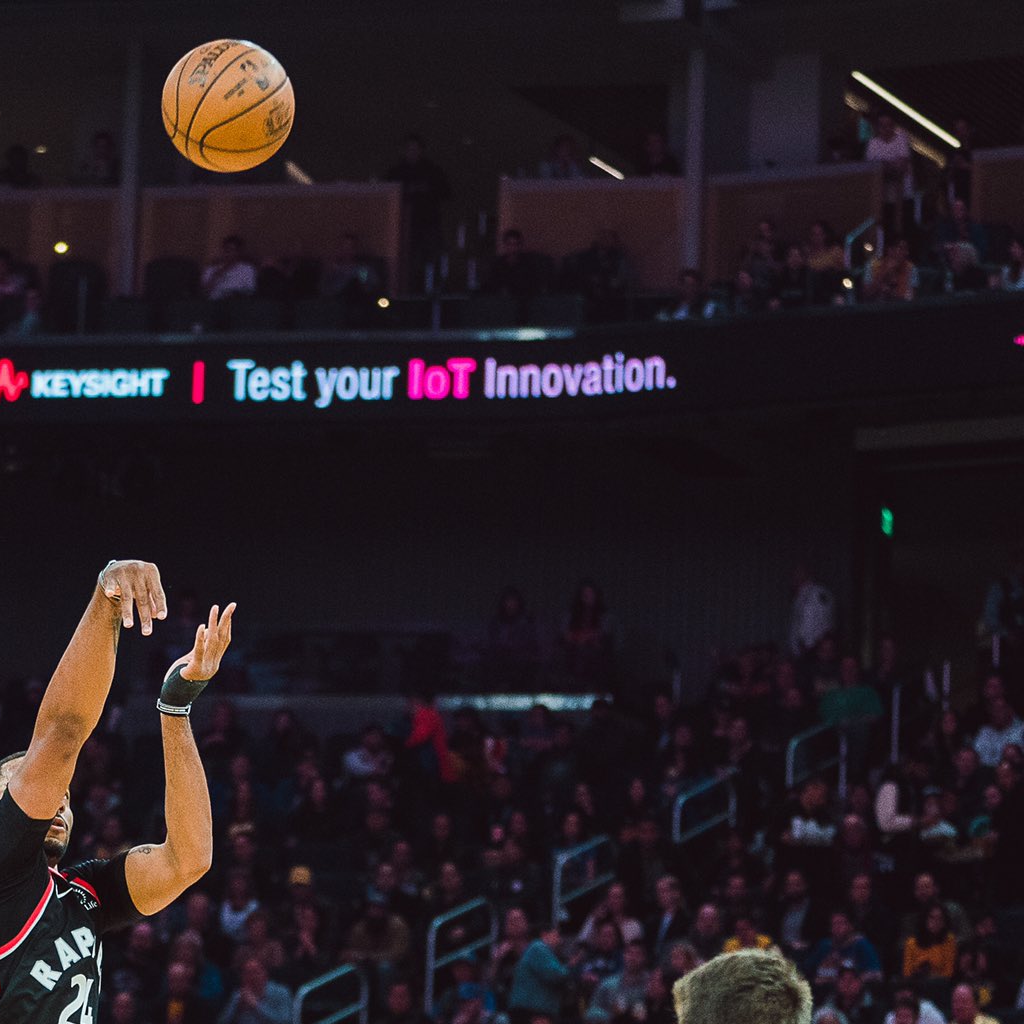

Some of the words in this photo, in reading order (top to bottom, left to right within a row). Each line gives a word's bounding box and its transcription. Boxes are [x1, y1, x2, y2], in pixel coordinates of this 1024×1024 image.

[30, 367, 171, 399] KEYSIGHT
[226, 358, 308, 402] Test
[314, 366, 400, 408] your
[407, 357, 477, 400] IoT
[483, 351, 677, 400] Innovation.
[30, 926, 97, 992] RAP
